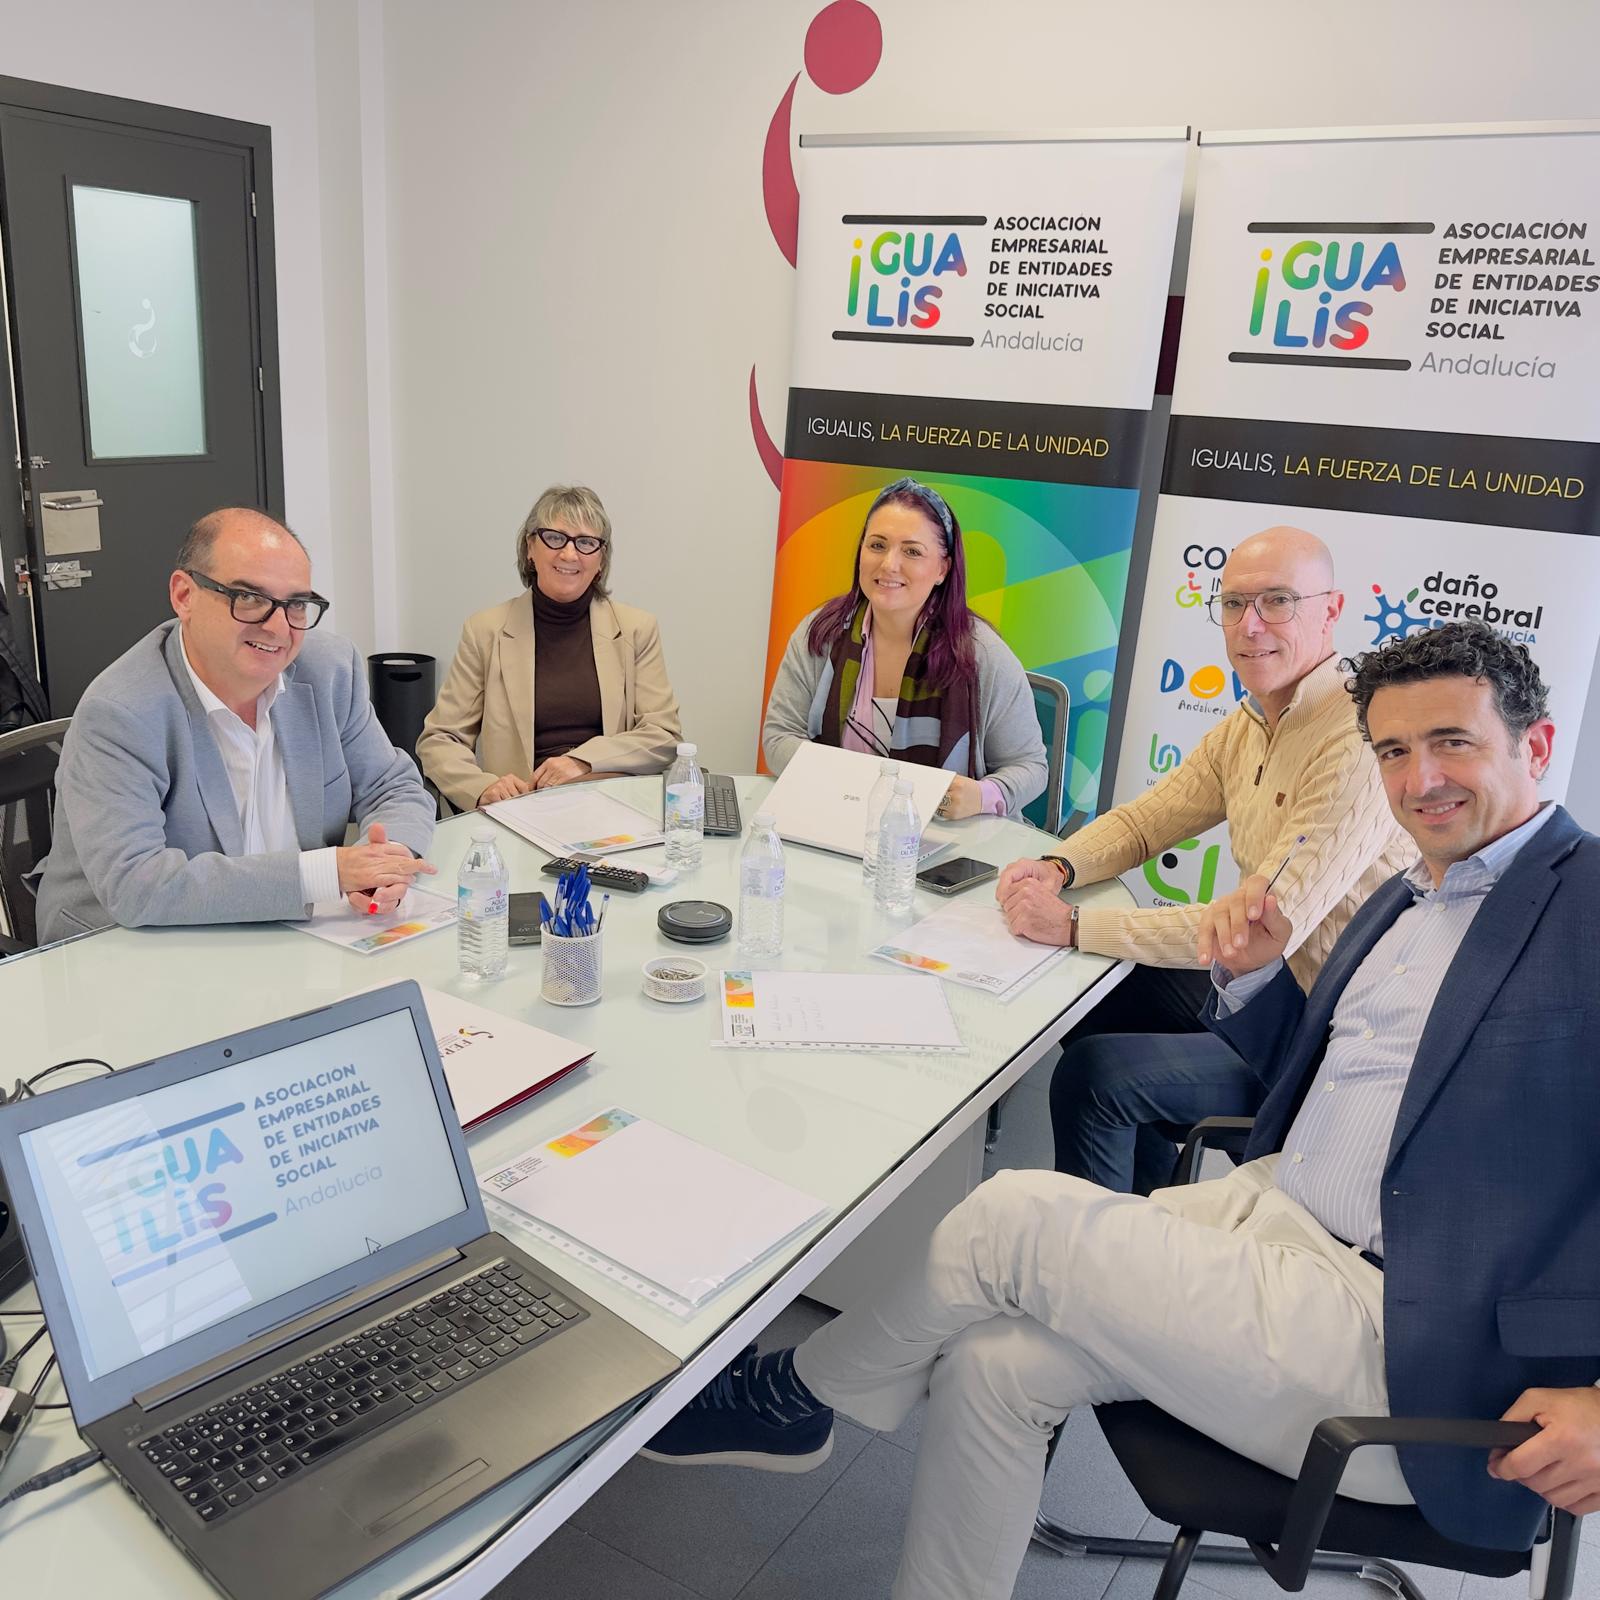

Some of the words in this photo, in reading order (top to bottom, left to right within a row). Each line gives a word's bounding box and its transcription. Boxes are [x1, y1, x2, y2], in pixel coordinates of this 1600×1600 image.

[994, 213, 1101, 231] ASOCIACIÓN
[1443, 219, 1587, 240] ASOCIACIÓN
[991, 238, 1108, 254] EMPRESARIAL
[1438, 248, 1596, 266] EMPRESARIAL
[989, 261, 1010, 275] DE
[1018, 261, 1113, 277] ENTIDADES
[986, 283, 1008, 297] DE
[1016, 283, 1100, 298] INICIATIVA
[1434, 274, 1462, 290] DE
[1472, 274, 1600, 292] ENTIDADES
[984, 303, 1044, 319] SOCIAL
[1430, 298, 1458, 314] DE
[1468, 299, 1582, 317] INICIATIVA
[980, 330, 1083, 353] Andalucía
[1426, 322, 1505, 340] SOCIAL
[1419, 352, 1556, 378] Andalucía
[807, 417, 875, 442] IGUALIS,
[880, 424, 902, 441] LA
[906, 425, 971, 447] FUERZA
[977, 431, 1002, 449] DE
[1007, 433, 1029, 451] LA
[1035, 437, 1109, 457] UNIDAD
[1191, 449, 1276, 476] IGUALIS,
[1284, 455, 1310, 475] LA
[1318, 458, 1401, 483] FUERZA
[1410, 465, 1441, 487] DE
[1448, 469, 1476, 490] LA
[1485, 473, 1584, 499] UNIDAD
[1423, 571, 1498, 600] daño
[1420, 598, 1543, 629] cerebral
[258, 1081, 371, 1130] EMPRESARIAL
[264, 1130, 287, 1149] DE
[293, 1095, 382, 1140] ENTIDADES
[270, 1150, 293, 1169] DE
[299, 1118, 380, 1157] INICIATIVA
[275, 1156, 337, 1188] SOCIAL
